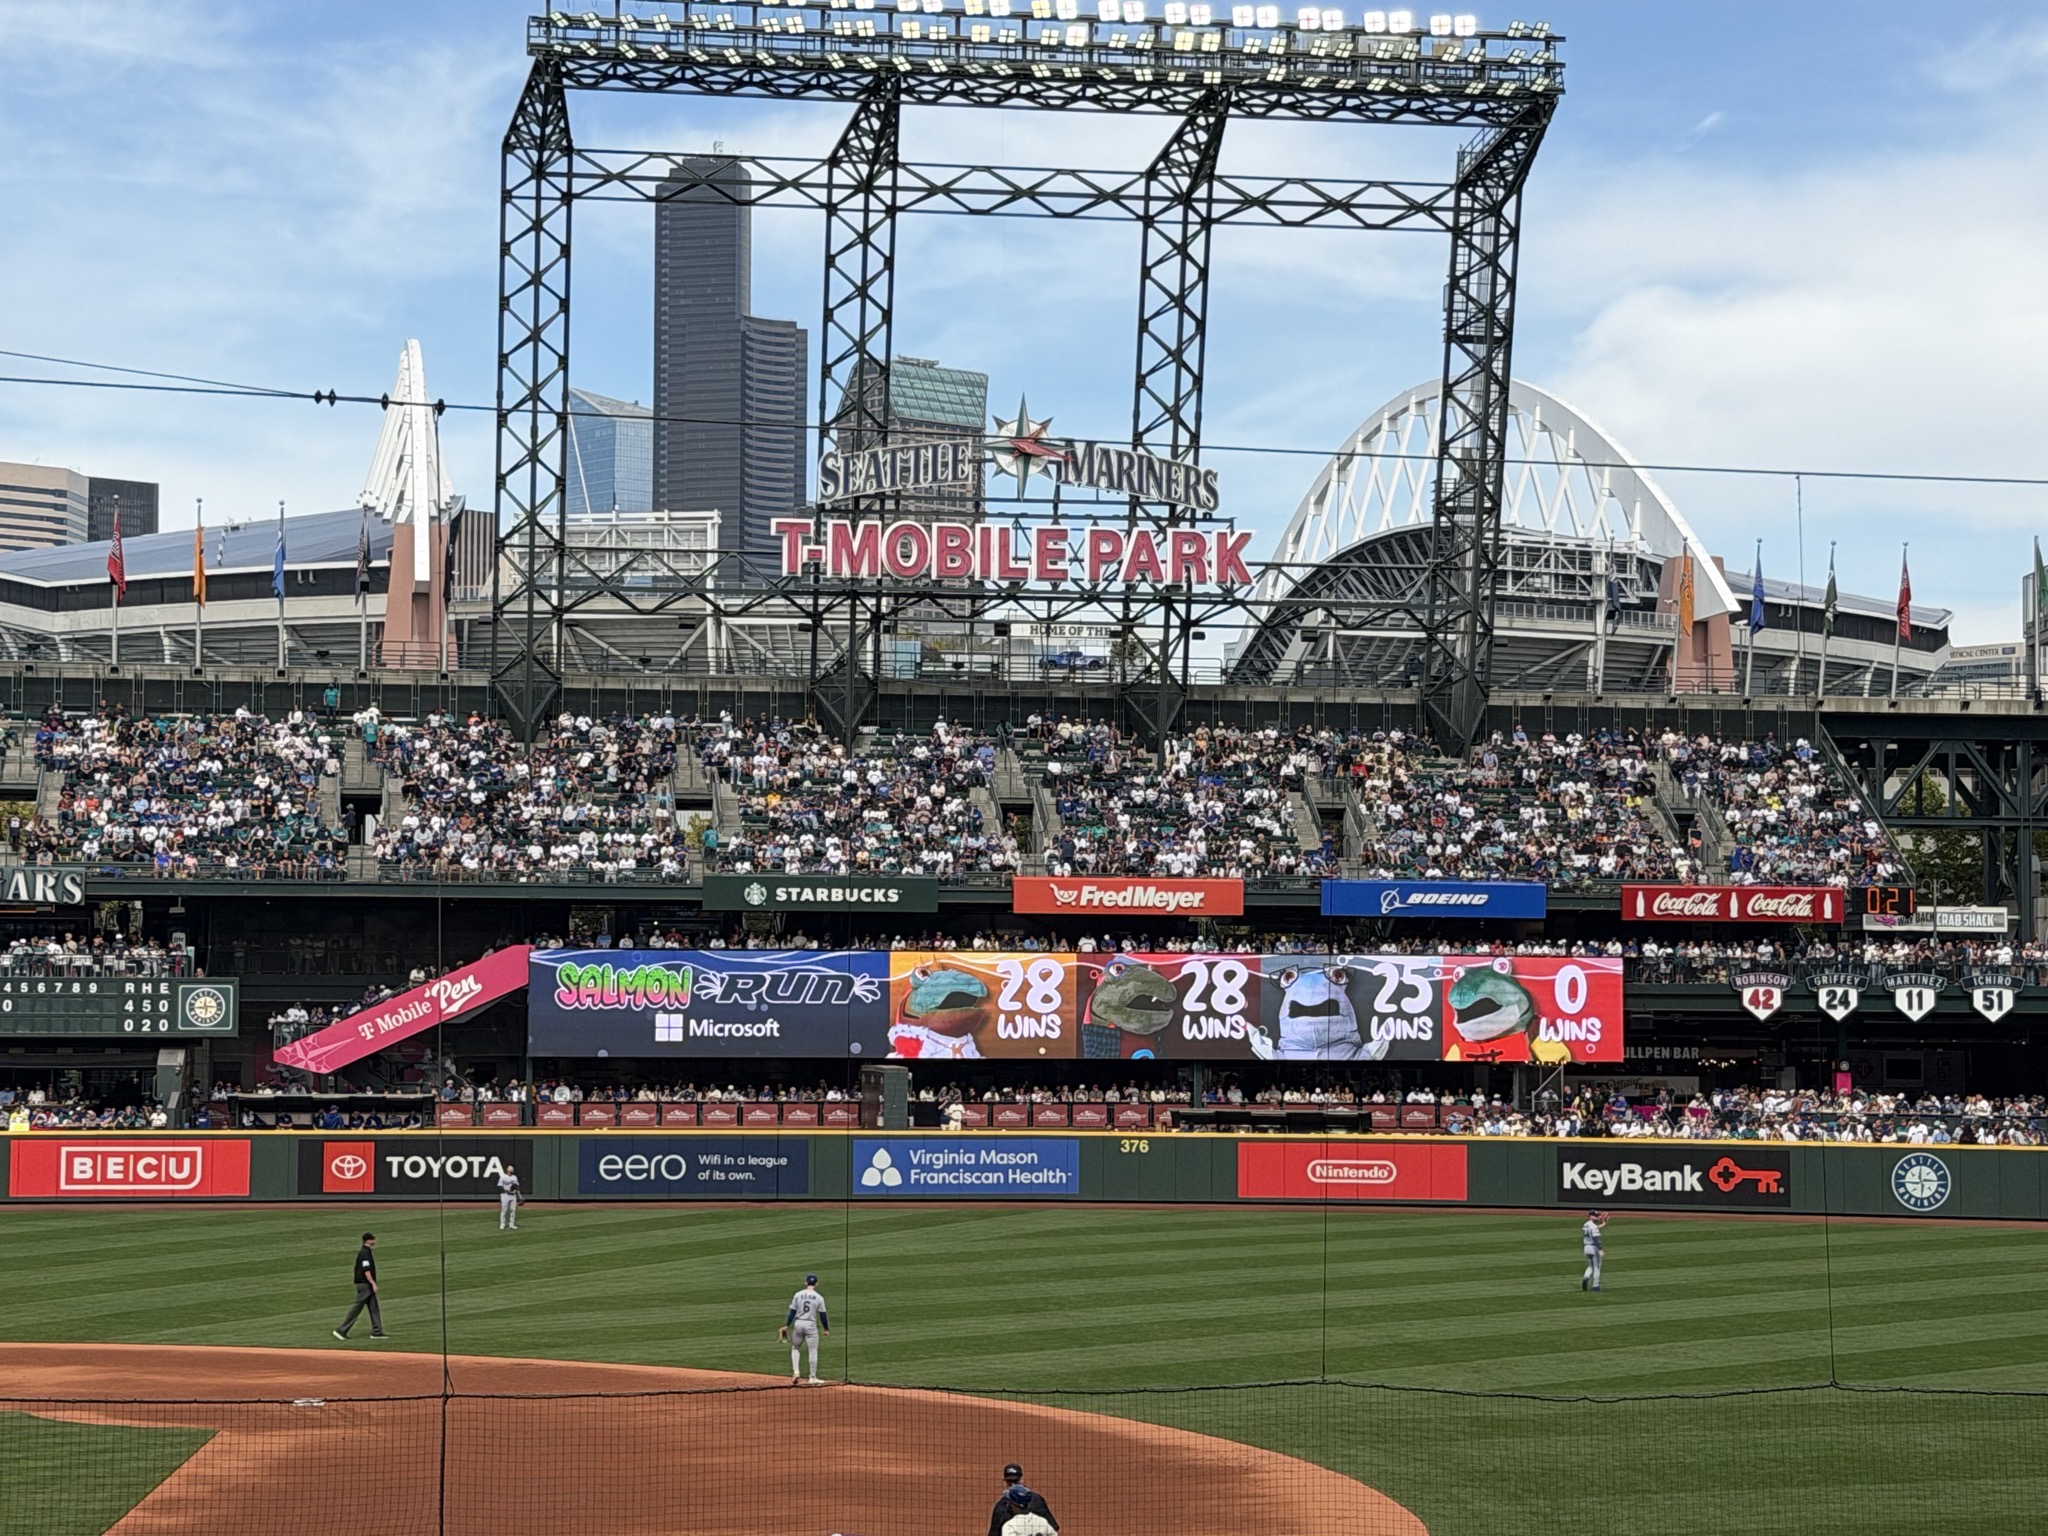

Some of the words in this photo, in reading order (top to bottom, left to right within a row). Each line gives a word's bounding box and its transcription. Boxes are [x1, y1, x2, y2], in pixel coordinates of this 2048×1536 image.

[819, 440, 972, 503] SEATTLE
[1057, 439, 1220, 512] MARINERS
[770, 517, 1070, 583] T-MOBILE
[1083, 526, 1256, 586] PARK
[1030, 625, 1066, 636] HOME
[1068, 626, 1085, 636] OF
[1087, 626, 1111, 637] THE
[0, 869, 83, 904] ARS
[775, 886, 900, 903] STARBUCKS
[1406, 893, 1489, 905] BOEING
[1652, 892, 1722, 916] Coca-Cola
[1747, 893, 1816, 917] Coca-Cola
[1937, 914, 1961, 926] CRAB
[1964, 915, 1995, 927] SHACK
[3, 982, 12, 993] 4
[20, 982, 29, 993] 5
[37, 982, 46, 993] 6
[54, 982, 63, 993] 7
[72, 982, 81, 993] 8
[89, 982, 98, 993] 9
[125, 983, 135, 994] R
[142, 983, 152, 994] H
[160, 983, 170, 994] E
[554, 961, 693, 1011] SALMON
[996, 959, 1064, 1013] 28
[1181, 959, 1249, 1015] 28
[1371, 958, 1433, 1014] 25
[1554, 965, 1587, 1015] 0
[1736, 974, 1788, 987] ROBINSON
[1814, 974, 1860, 986] GRIFFEY
[1887, 975, 1943, 988] MARTINEZ
[1973, 976, 2012, 987] ICHIRO
[2, 999, 13, 1012] 0
[124, 1000, 134, 1012] 4
[142, 1000, 151, 1012] 5
[159, 1000, 169, 1012] 0
[1748, 989, 1774, 1010] 42
[1826, 990, 1851, 1010] 24
[1906, 990, 1924, 1011] 11
[1982, 990, 2004, 1012] 51
[124, 1019, 134, 1032] 0
[142, 1019, 152, 1032] 2
[159, 1019, 169, 1032] 0
[375, 1001, 433, 1034] Mobile
[689, 1018, 780, 1038] Microsoft
[997, 1014, 1061, 1039] WINS
[1182, 1014, 1246, 1040] WINS
[1371, 1015, 1434, 1041] WINS
[1539, 1016, 1601, 1042] WINS
[1673, 1047, 1700, 1059] BAR
[1120, 1140, 1149, 1153] 376
[72, 1155, 191, 1180] BECU
[386, 1156, 504, 1179] TOYOTA
[599, 1154, 687, 1181] eero
[698, 1154, 721, 1165] Wifi
[724, 1154, 734, 1165] in
[737, 1157, 745, 1165] a
[748, 1154, 788, 1168] league
[909, 1149, 976, 1169] Virginia
[979, 1150, 1038, 1165] Mason
[698, 1169, 710, 1180] of
[713, 1169, 726, 1180] its
[728, 1171, 756, 1180] own.
[910, 1168, 1004, 1184] Franciscan
[1315, 1165, 1388, 1179] Nintendo
[1562, 1163, 1704, 1197] KeyBank
[803, 1301, 812, 1313] 6
